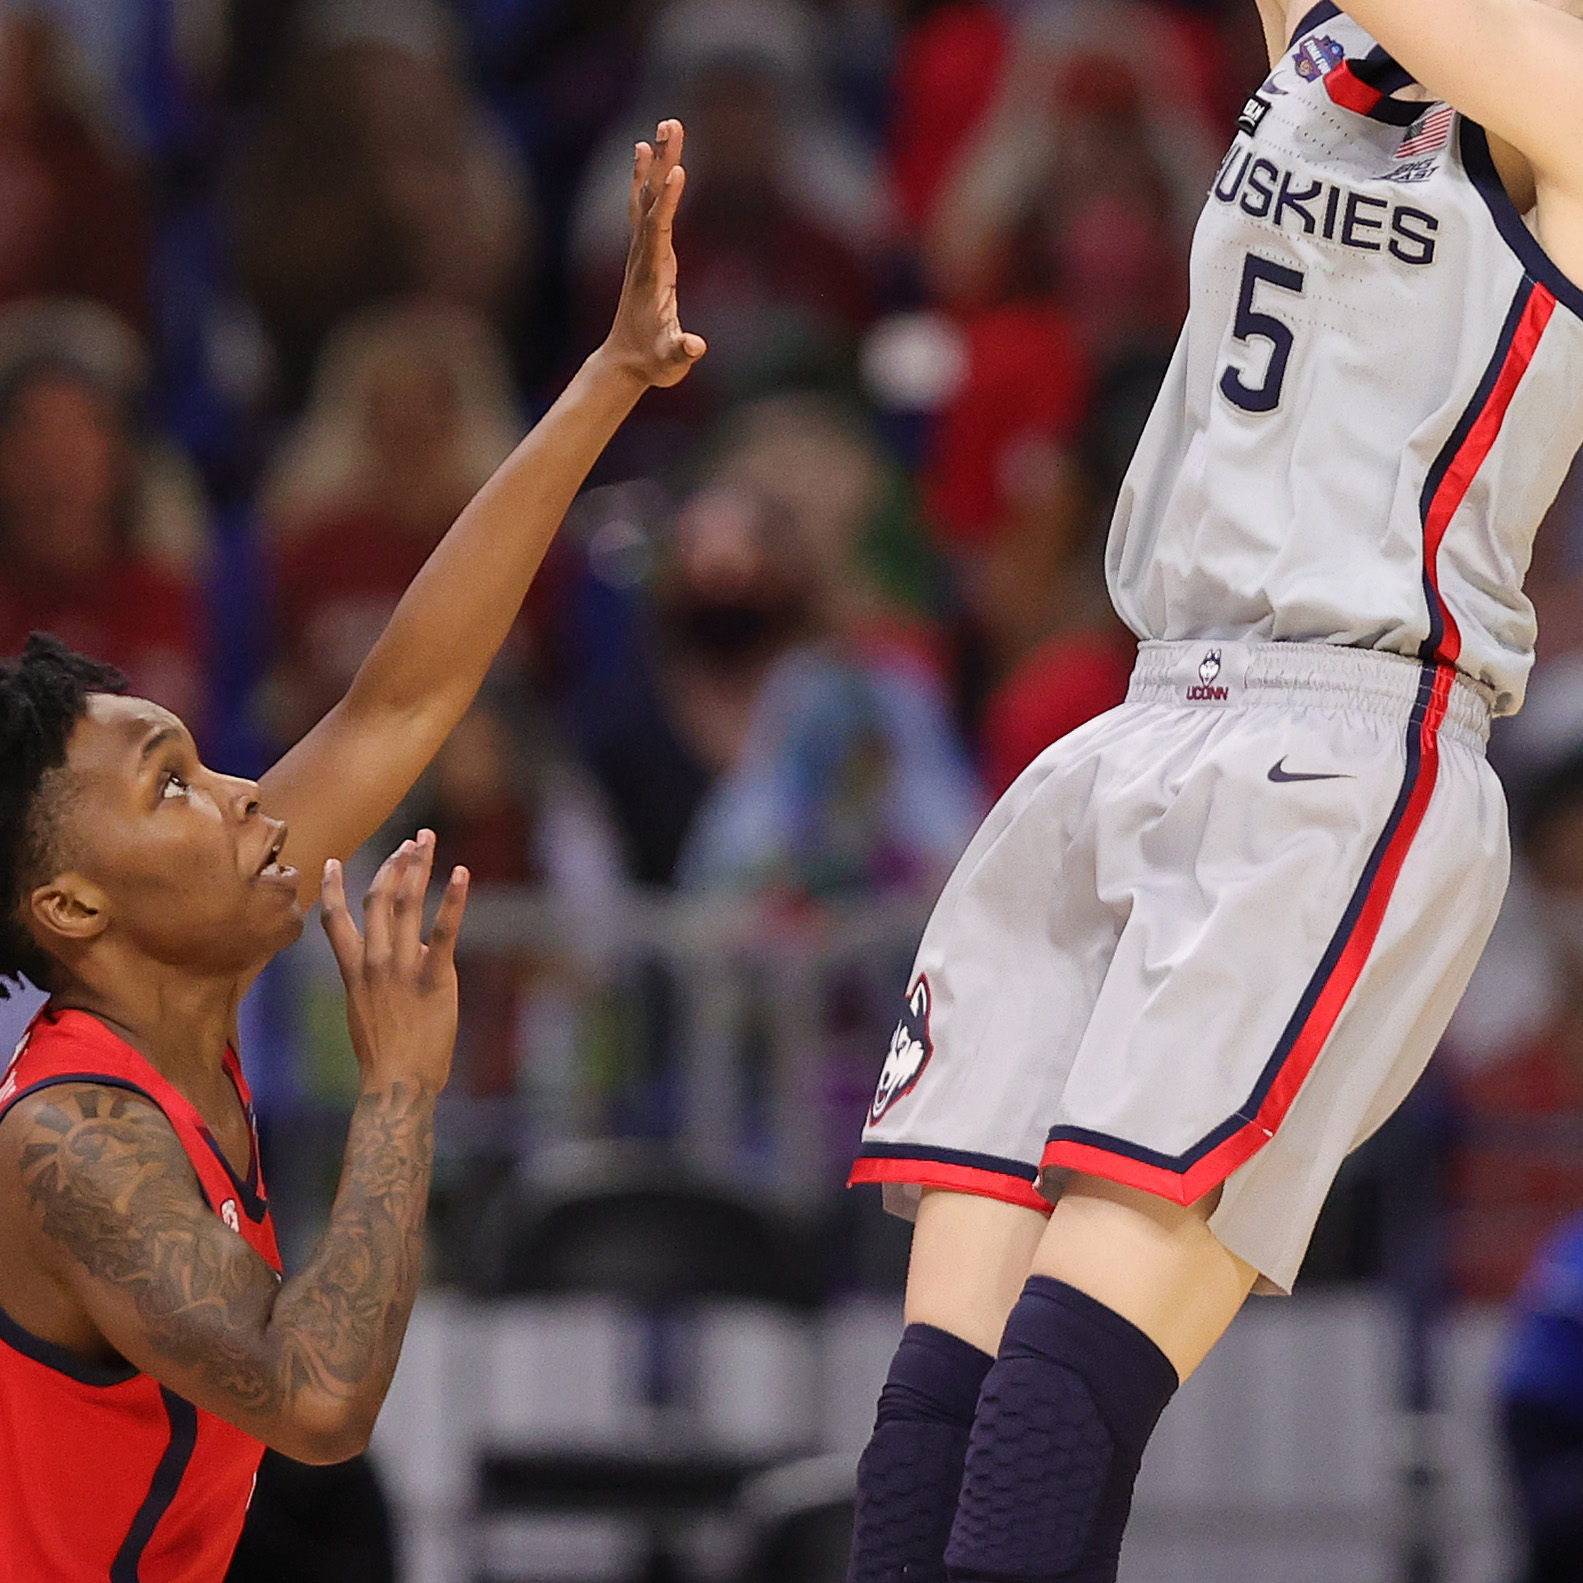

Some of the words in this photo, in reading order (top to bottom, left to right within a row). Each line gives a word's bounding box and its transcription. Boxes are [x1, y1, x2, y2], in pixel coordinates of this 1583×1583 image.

[1215, 144, 1439, 265] USKIES
[1219, 252, 1305, 413] 5
[1186, 685, 1229, 701] UCONN
